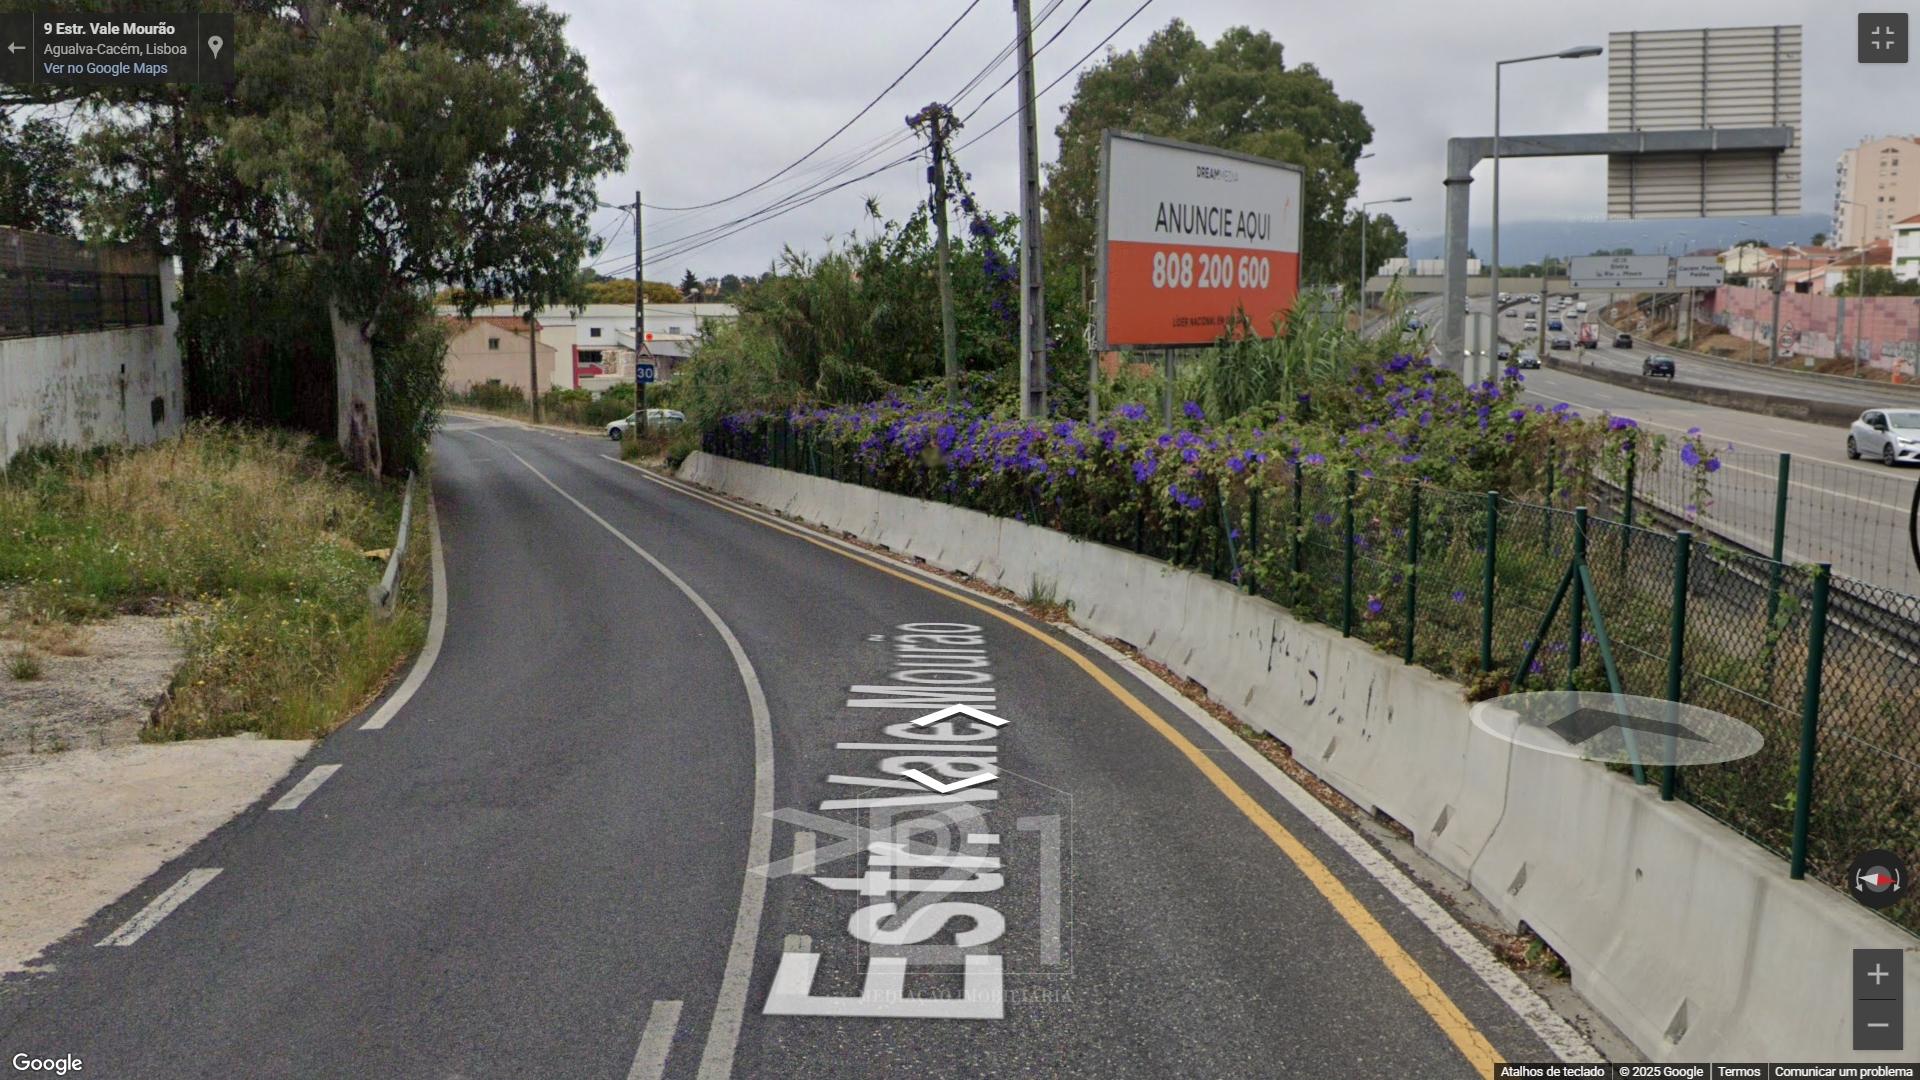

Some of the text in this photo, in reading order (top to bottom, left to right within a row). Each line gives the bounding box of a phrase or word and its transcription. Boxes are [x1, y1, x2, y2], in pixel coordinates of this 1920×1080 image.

[1155, 202, 1271, 243] ANUNCIE AQUI
[1152, 251, 1270, 289] 808 200 600
[636, 367, 653, 379] 30
